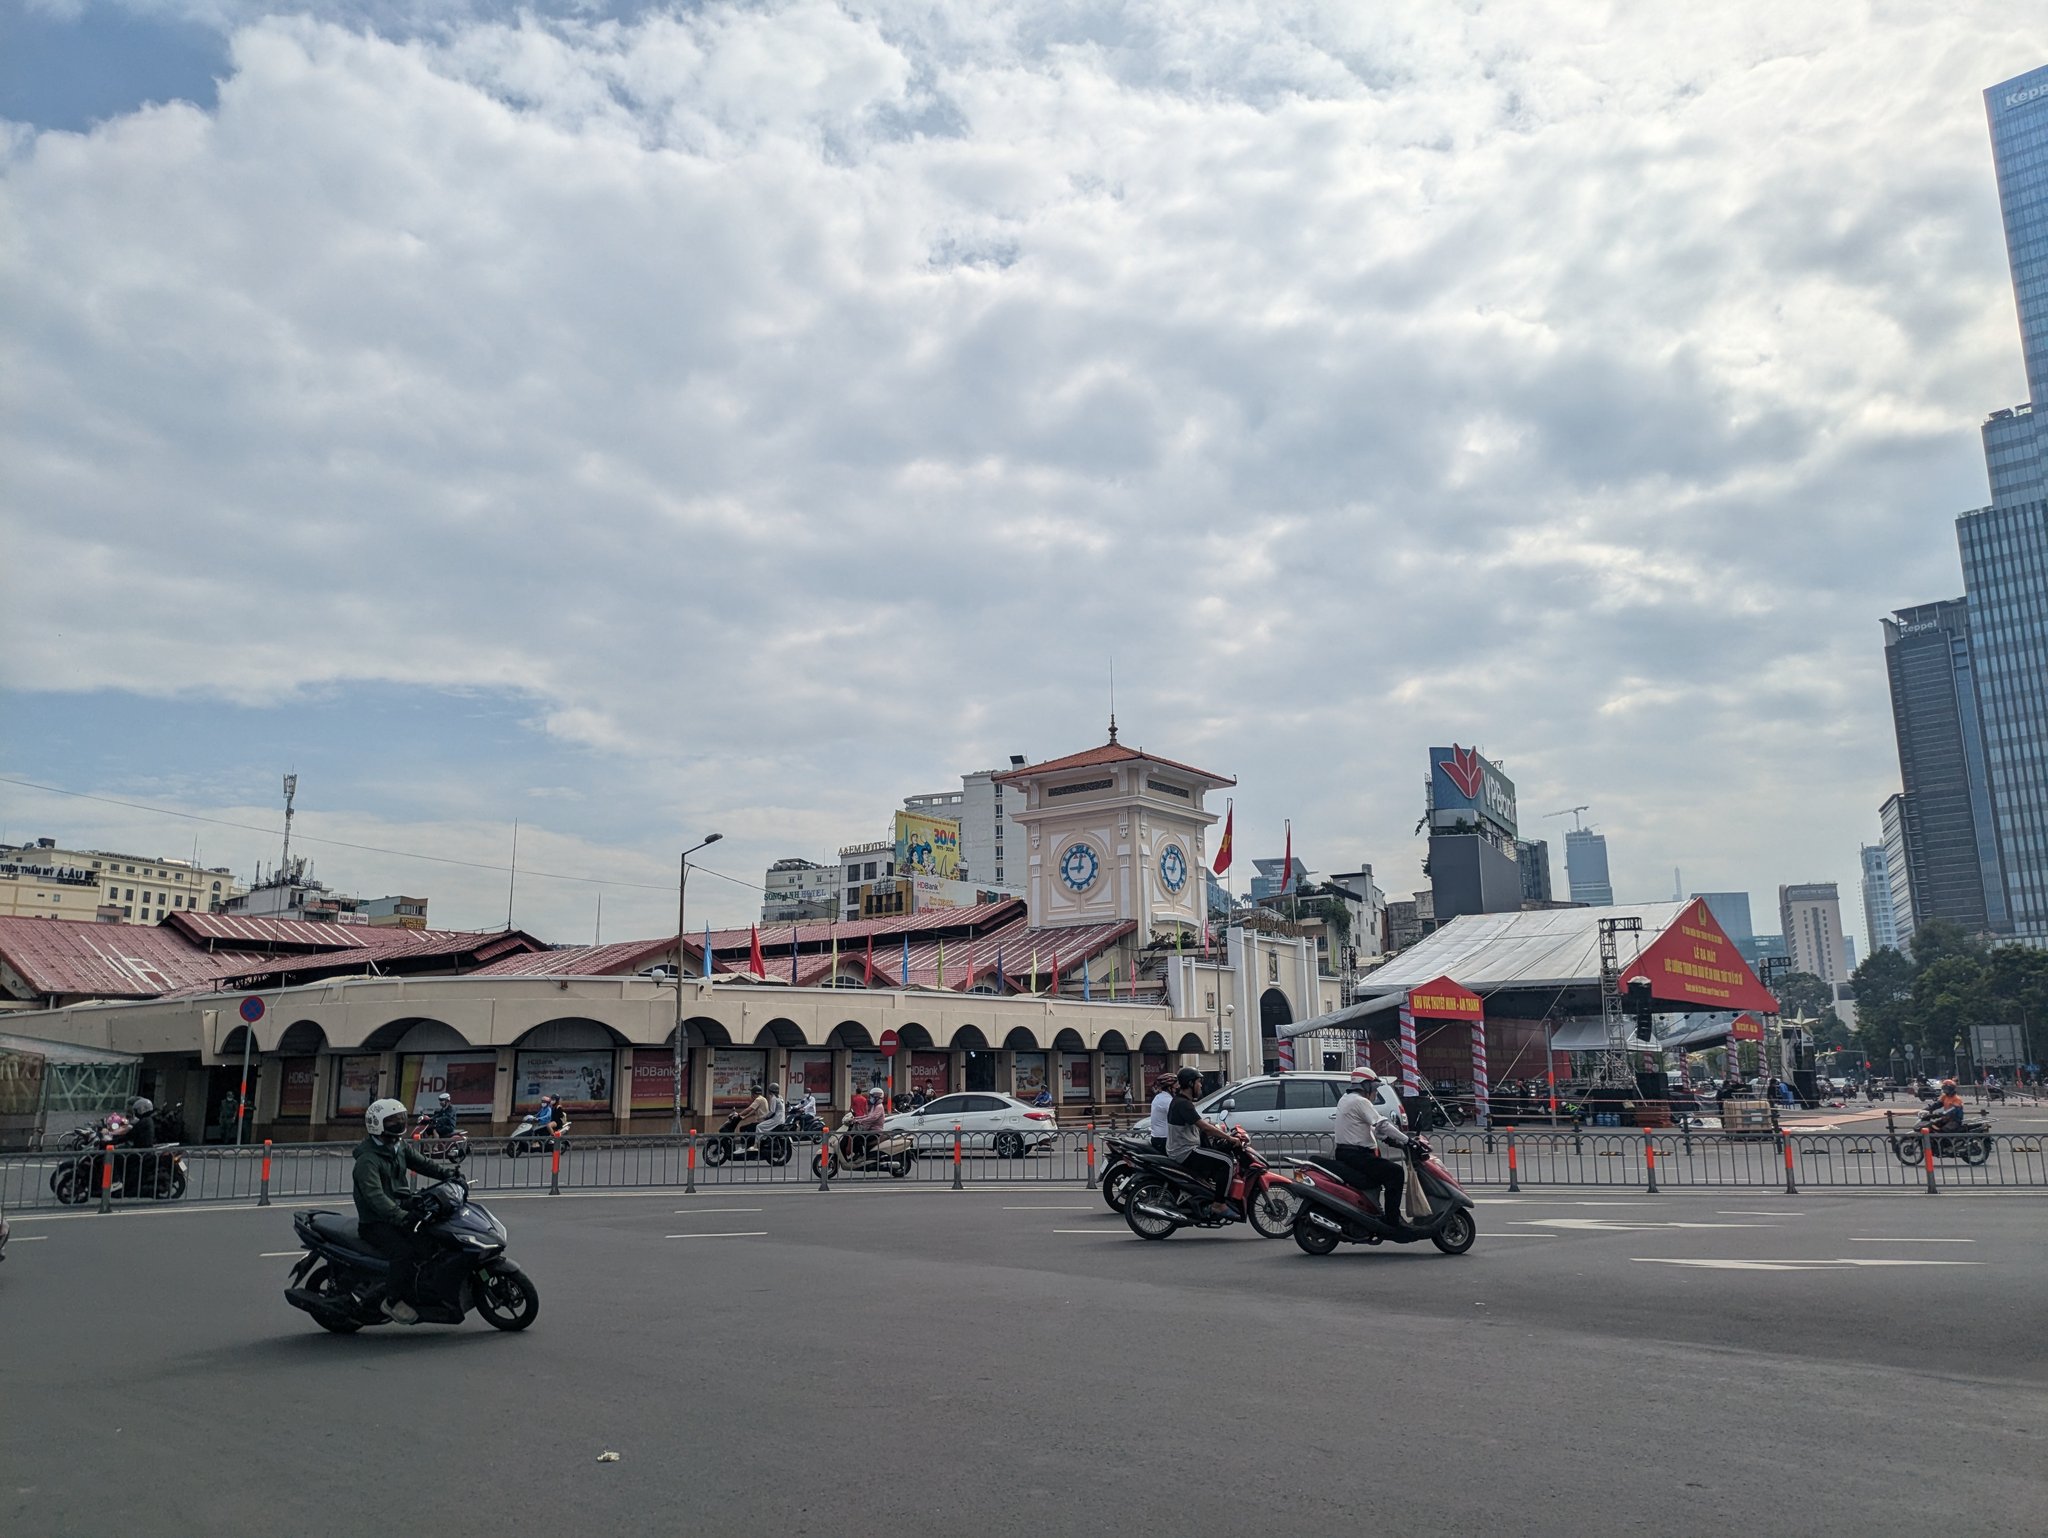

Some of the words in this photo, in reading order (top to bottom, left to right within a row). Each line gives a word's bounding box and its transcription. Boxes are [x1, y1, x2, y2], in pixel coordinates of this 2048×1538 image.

[1901, 620, 1937, 633] Keppel
[1483, 769, 1517, 825] VPBank
[934, 828, 956, 847] 30/4
[863, 841, 888, 853] HOTEL
[917, 881, 939, 890] HDBank
[800, 889, 826, 899] HOTEL
[634, 1066, 676, 1077] HDBank
